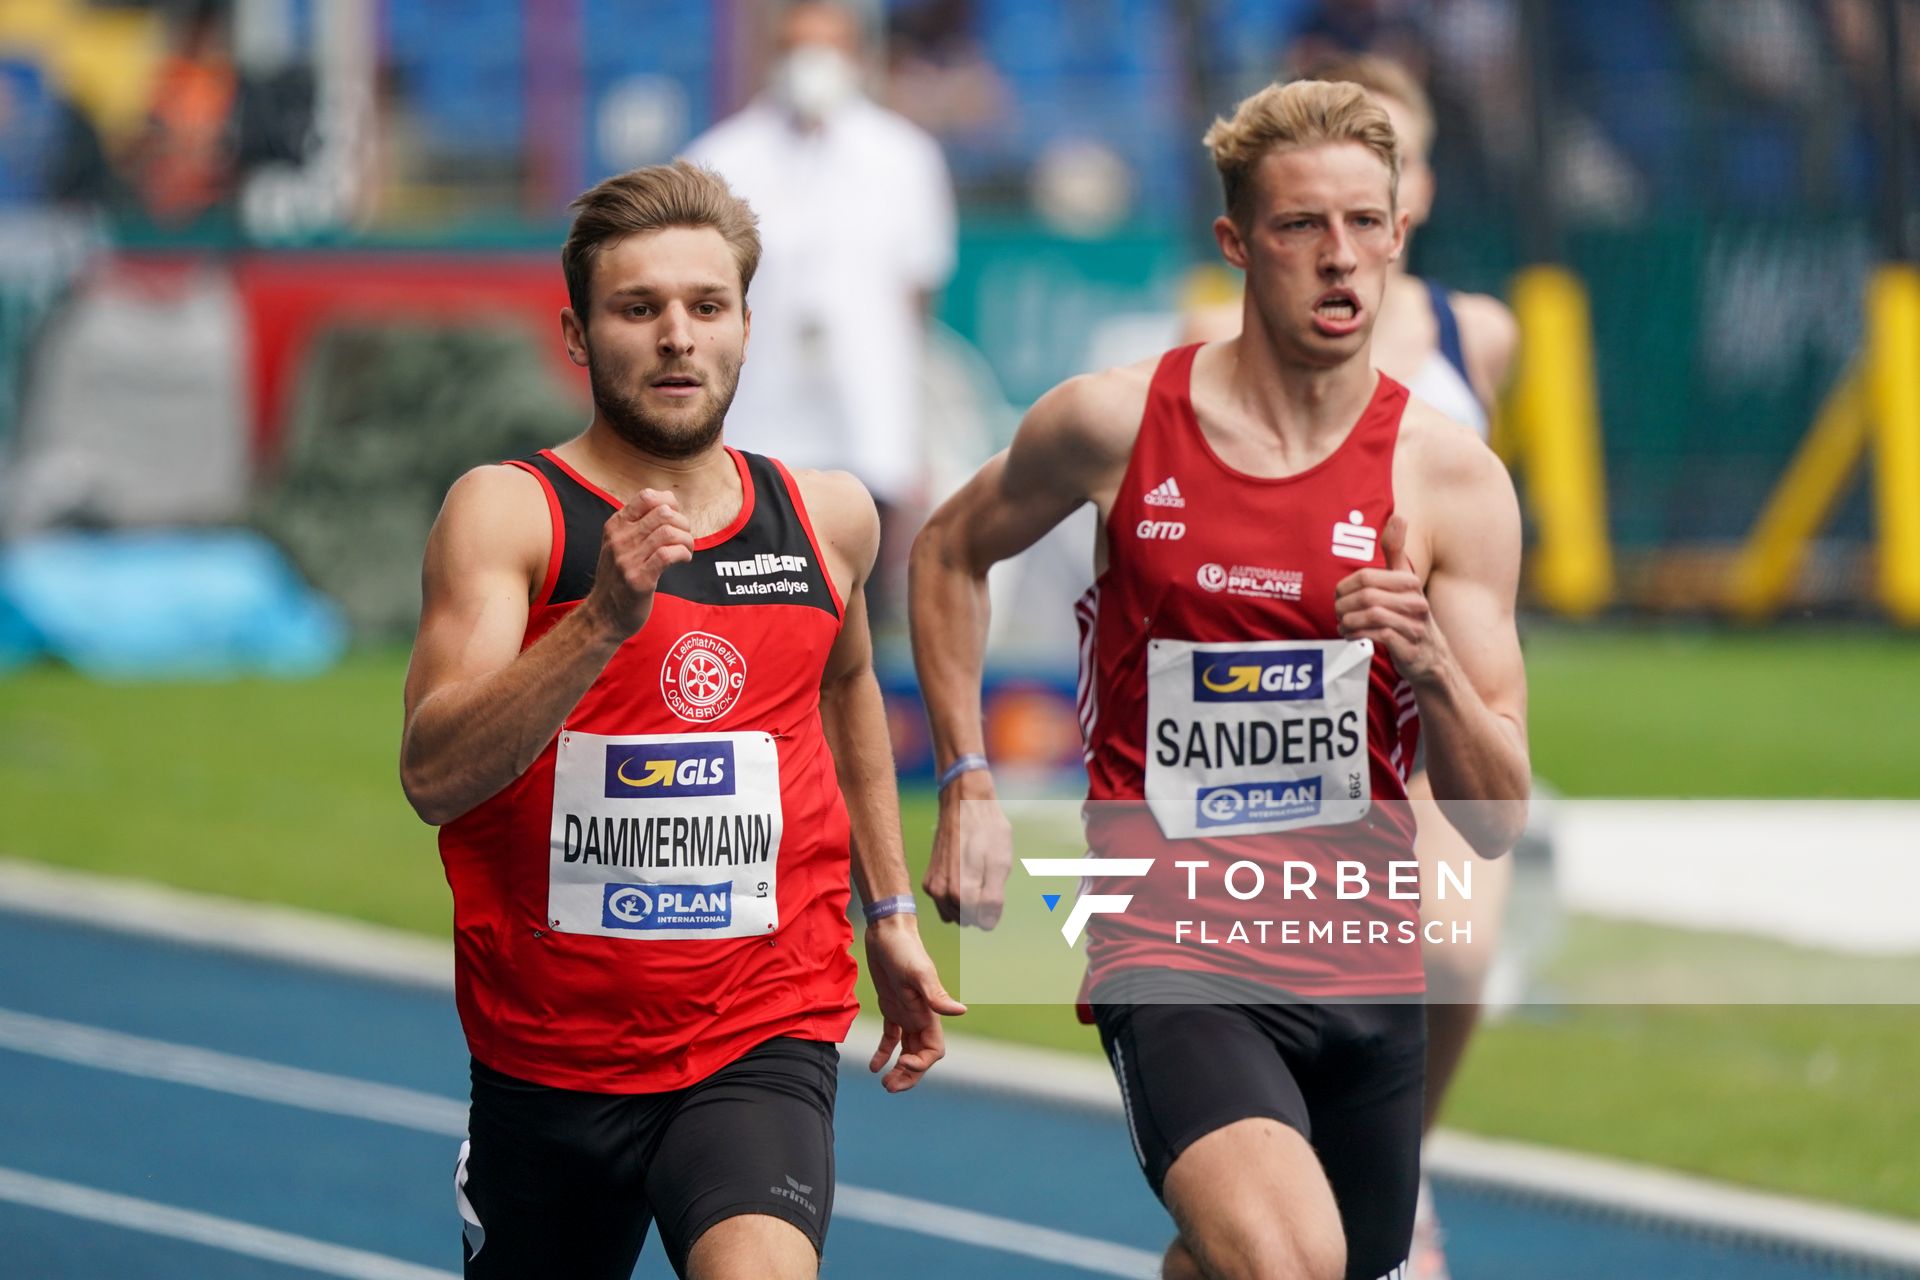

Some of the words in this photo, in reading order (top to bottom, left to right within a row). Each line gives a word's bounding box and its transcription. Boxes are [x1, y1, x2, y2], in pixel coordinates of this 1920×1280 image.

[1144, 493, 1185, 508] adidas
[715, 553, 807, 576] molitor
[725, 578, 809, 595] Laufanalyse
[1228, 577, 1302, 595] PFLANZ
[1261, 664, 1313, 692] GLS
[668, 689, 733, 718] OSNABRÜCK
[1156, 710, 1360, 769] SANDERS
[676, 757, 725, 786] GLS
[1248, 784, 1317, 809] PLAN
[1349, 772, 1362, 800] 299
[563, 813, 772, 868] DAMMERMANN
[657, 892, 727, 913] PLAN
[657, 914, 726, 923] INTERNATIONAL
[770, 1186, 816, 1215] erima
